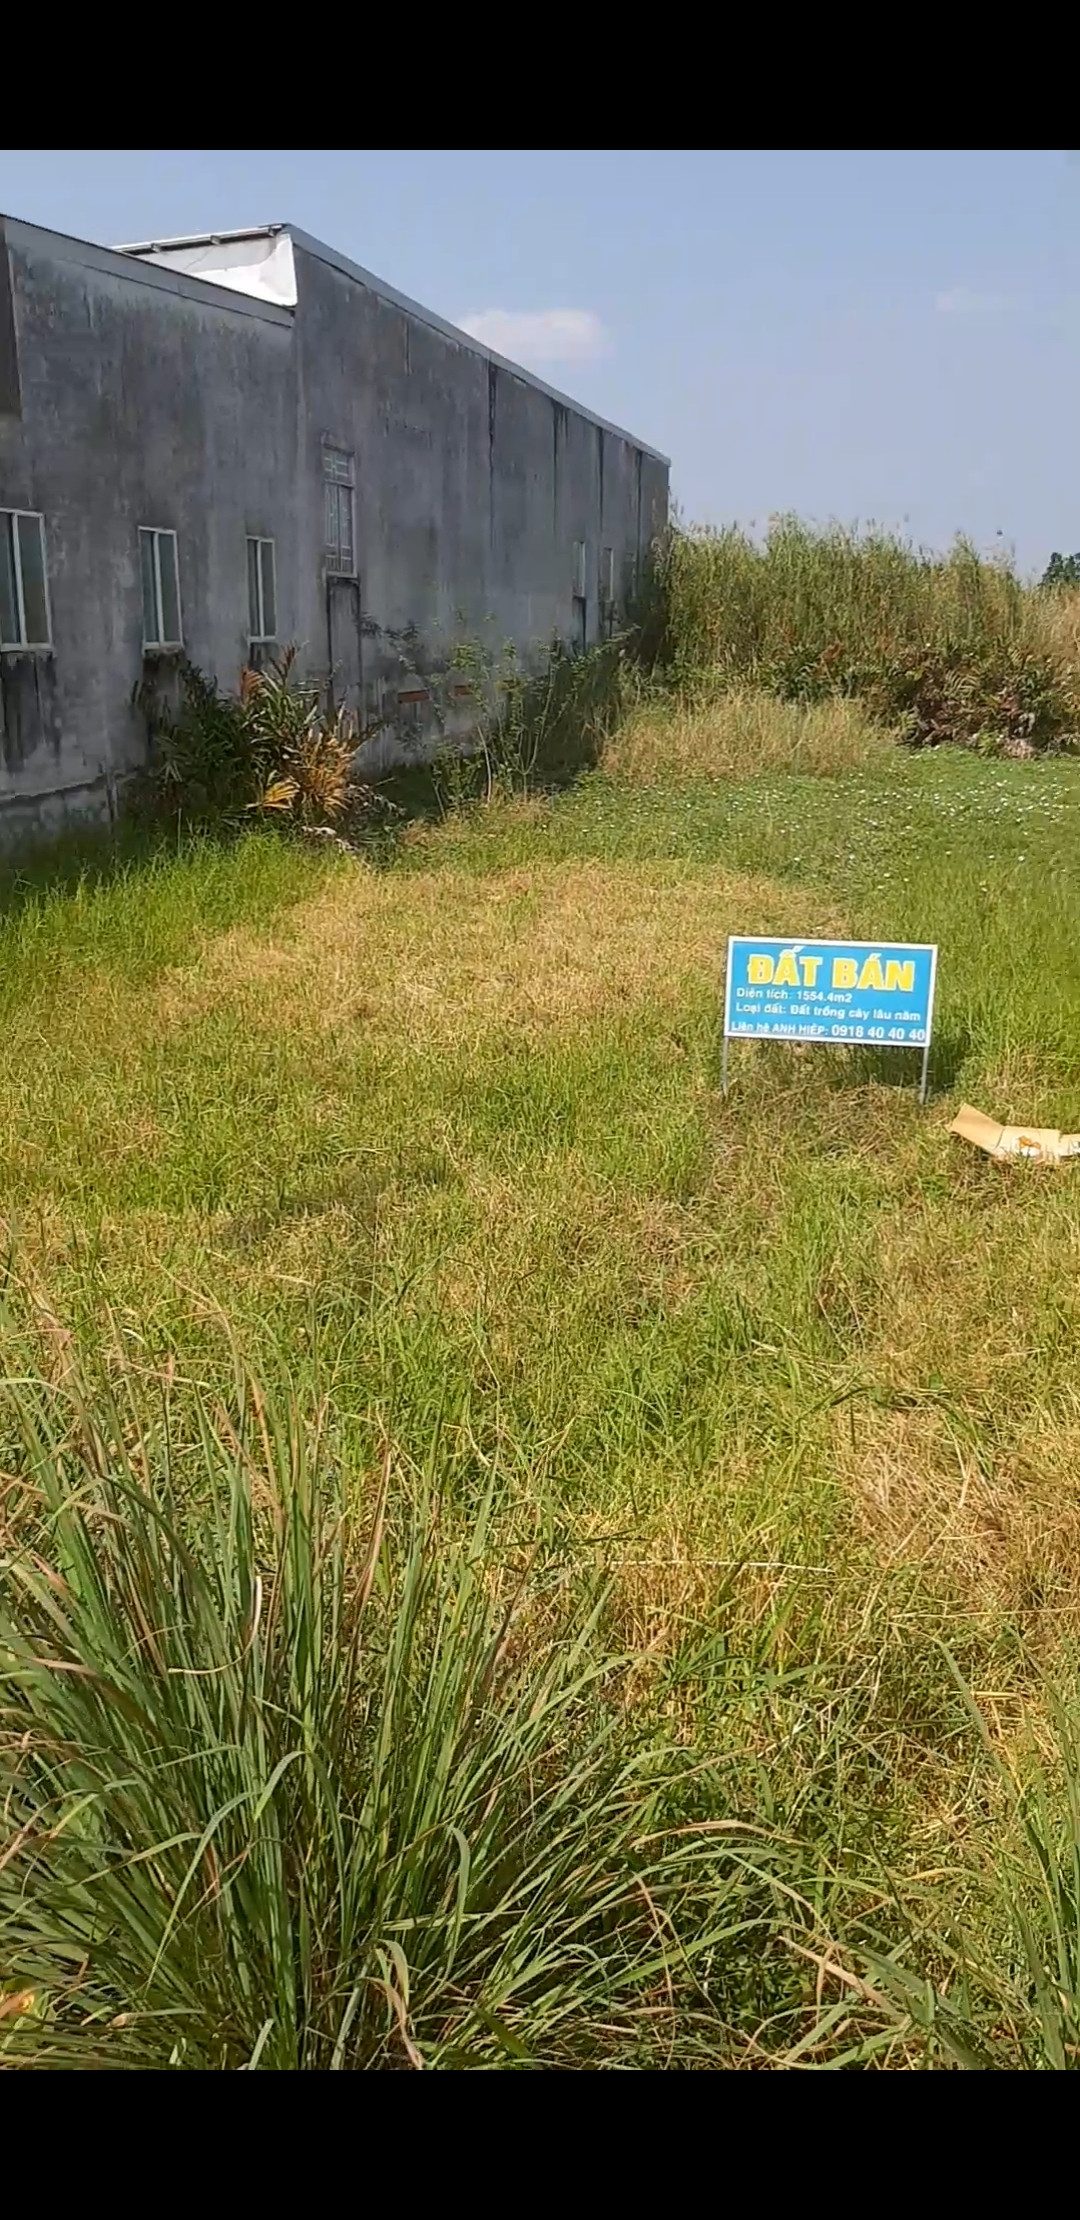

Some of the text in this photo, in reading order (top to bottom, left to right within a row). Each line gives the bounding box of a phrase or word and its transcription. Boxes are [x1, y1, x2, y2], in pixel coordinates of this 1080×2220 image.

[747, 946, 915, 992] ĐẤT BÁN
[873, 1009, 891, 1020] lâu
[732, 1021, 754, 1032] Liên
[772, 1024, 796, 1034] ANH
[832, 1024, 863, 1037] 0918
[868, 1026, 884, 1038] 40
[888, 1027, 904, 1039] 40
[909, 1028, 925, 1040] 40
